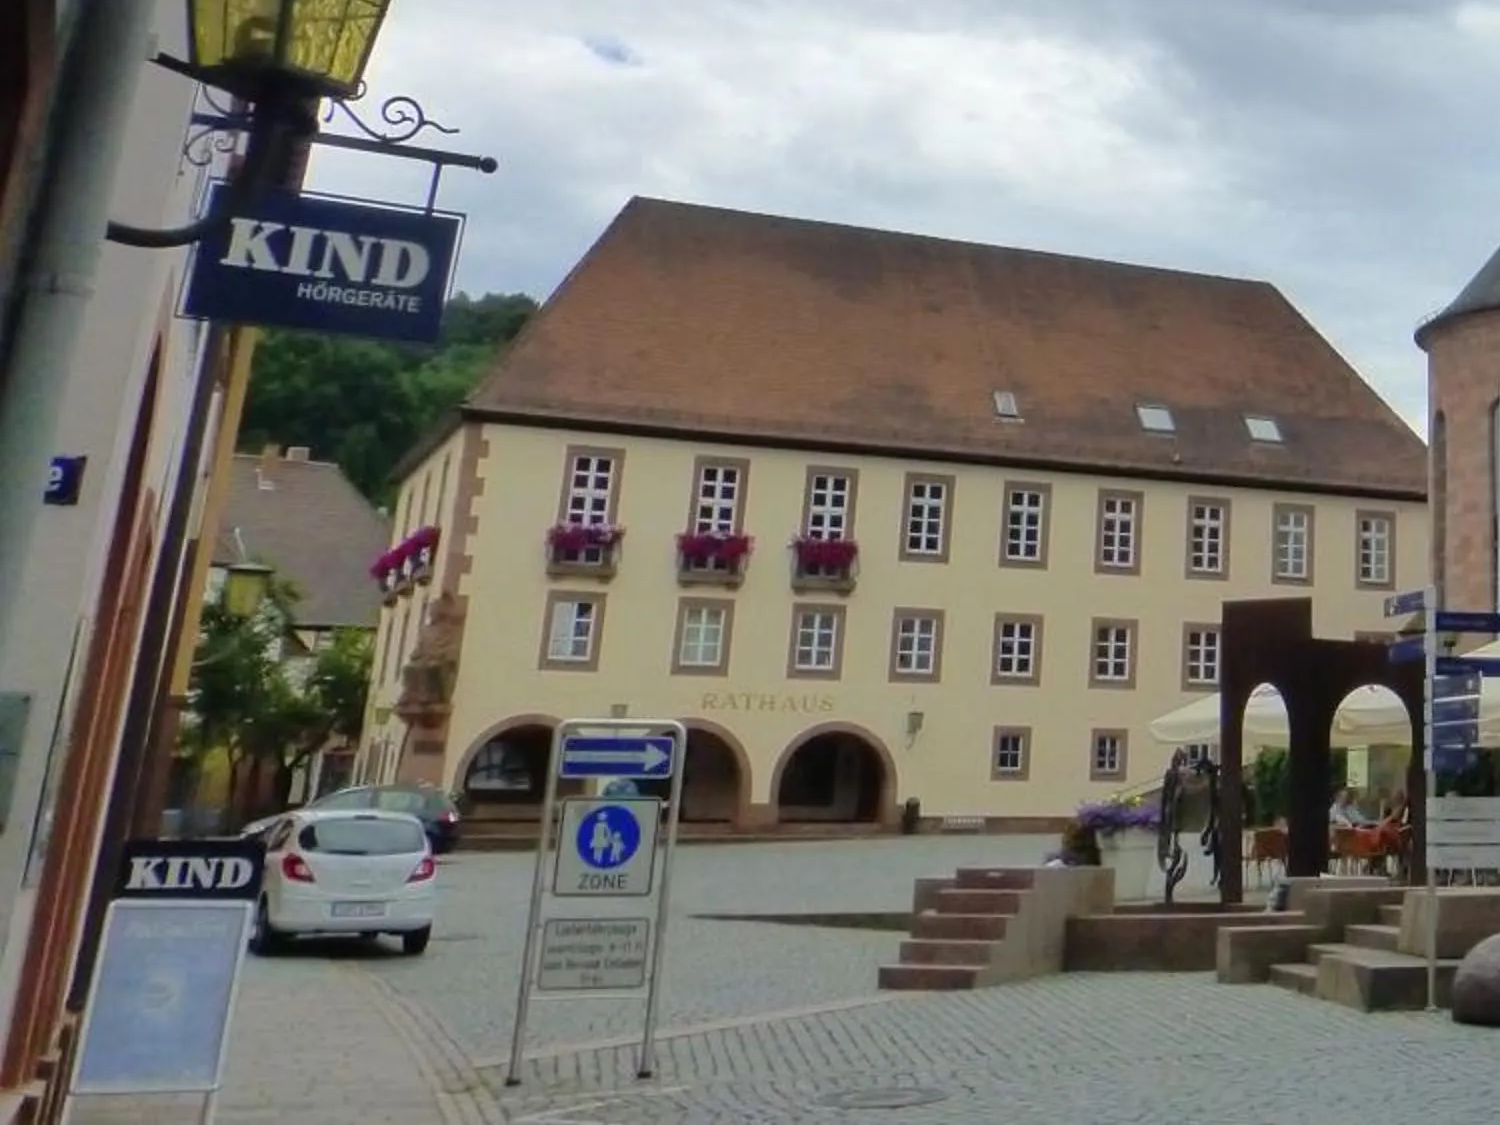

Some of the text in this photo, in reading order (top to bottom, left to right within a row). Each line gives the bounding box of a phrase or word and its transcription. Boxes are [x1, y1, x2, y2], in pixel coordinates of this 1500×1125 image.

[219, 217, 430, 288] KIND
[297, 281, 424, 313] HÖRGERÄTE
[701, 691, 835, 713] RATHAUS
[124, 856, 253, 889] KIND
[577, 873, 629, 890] ZONE
